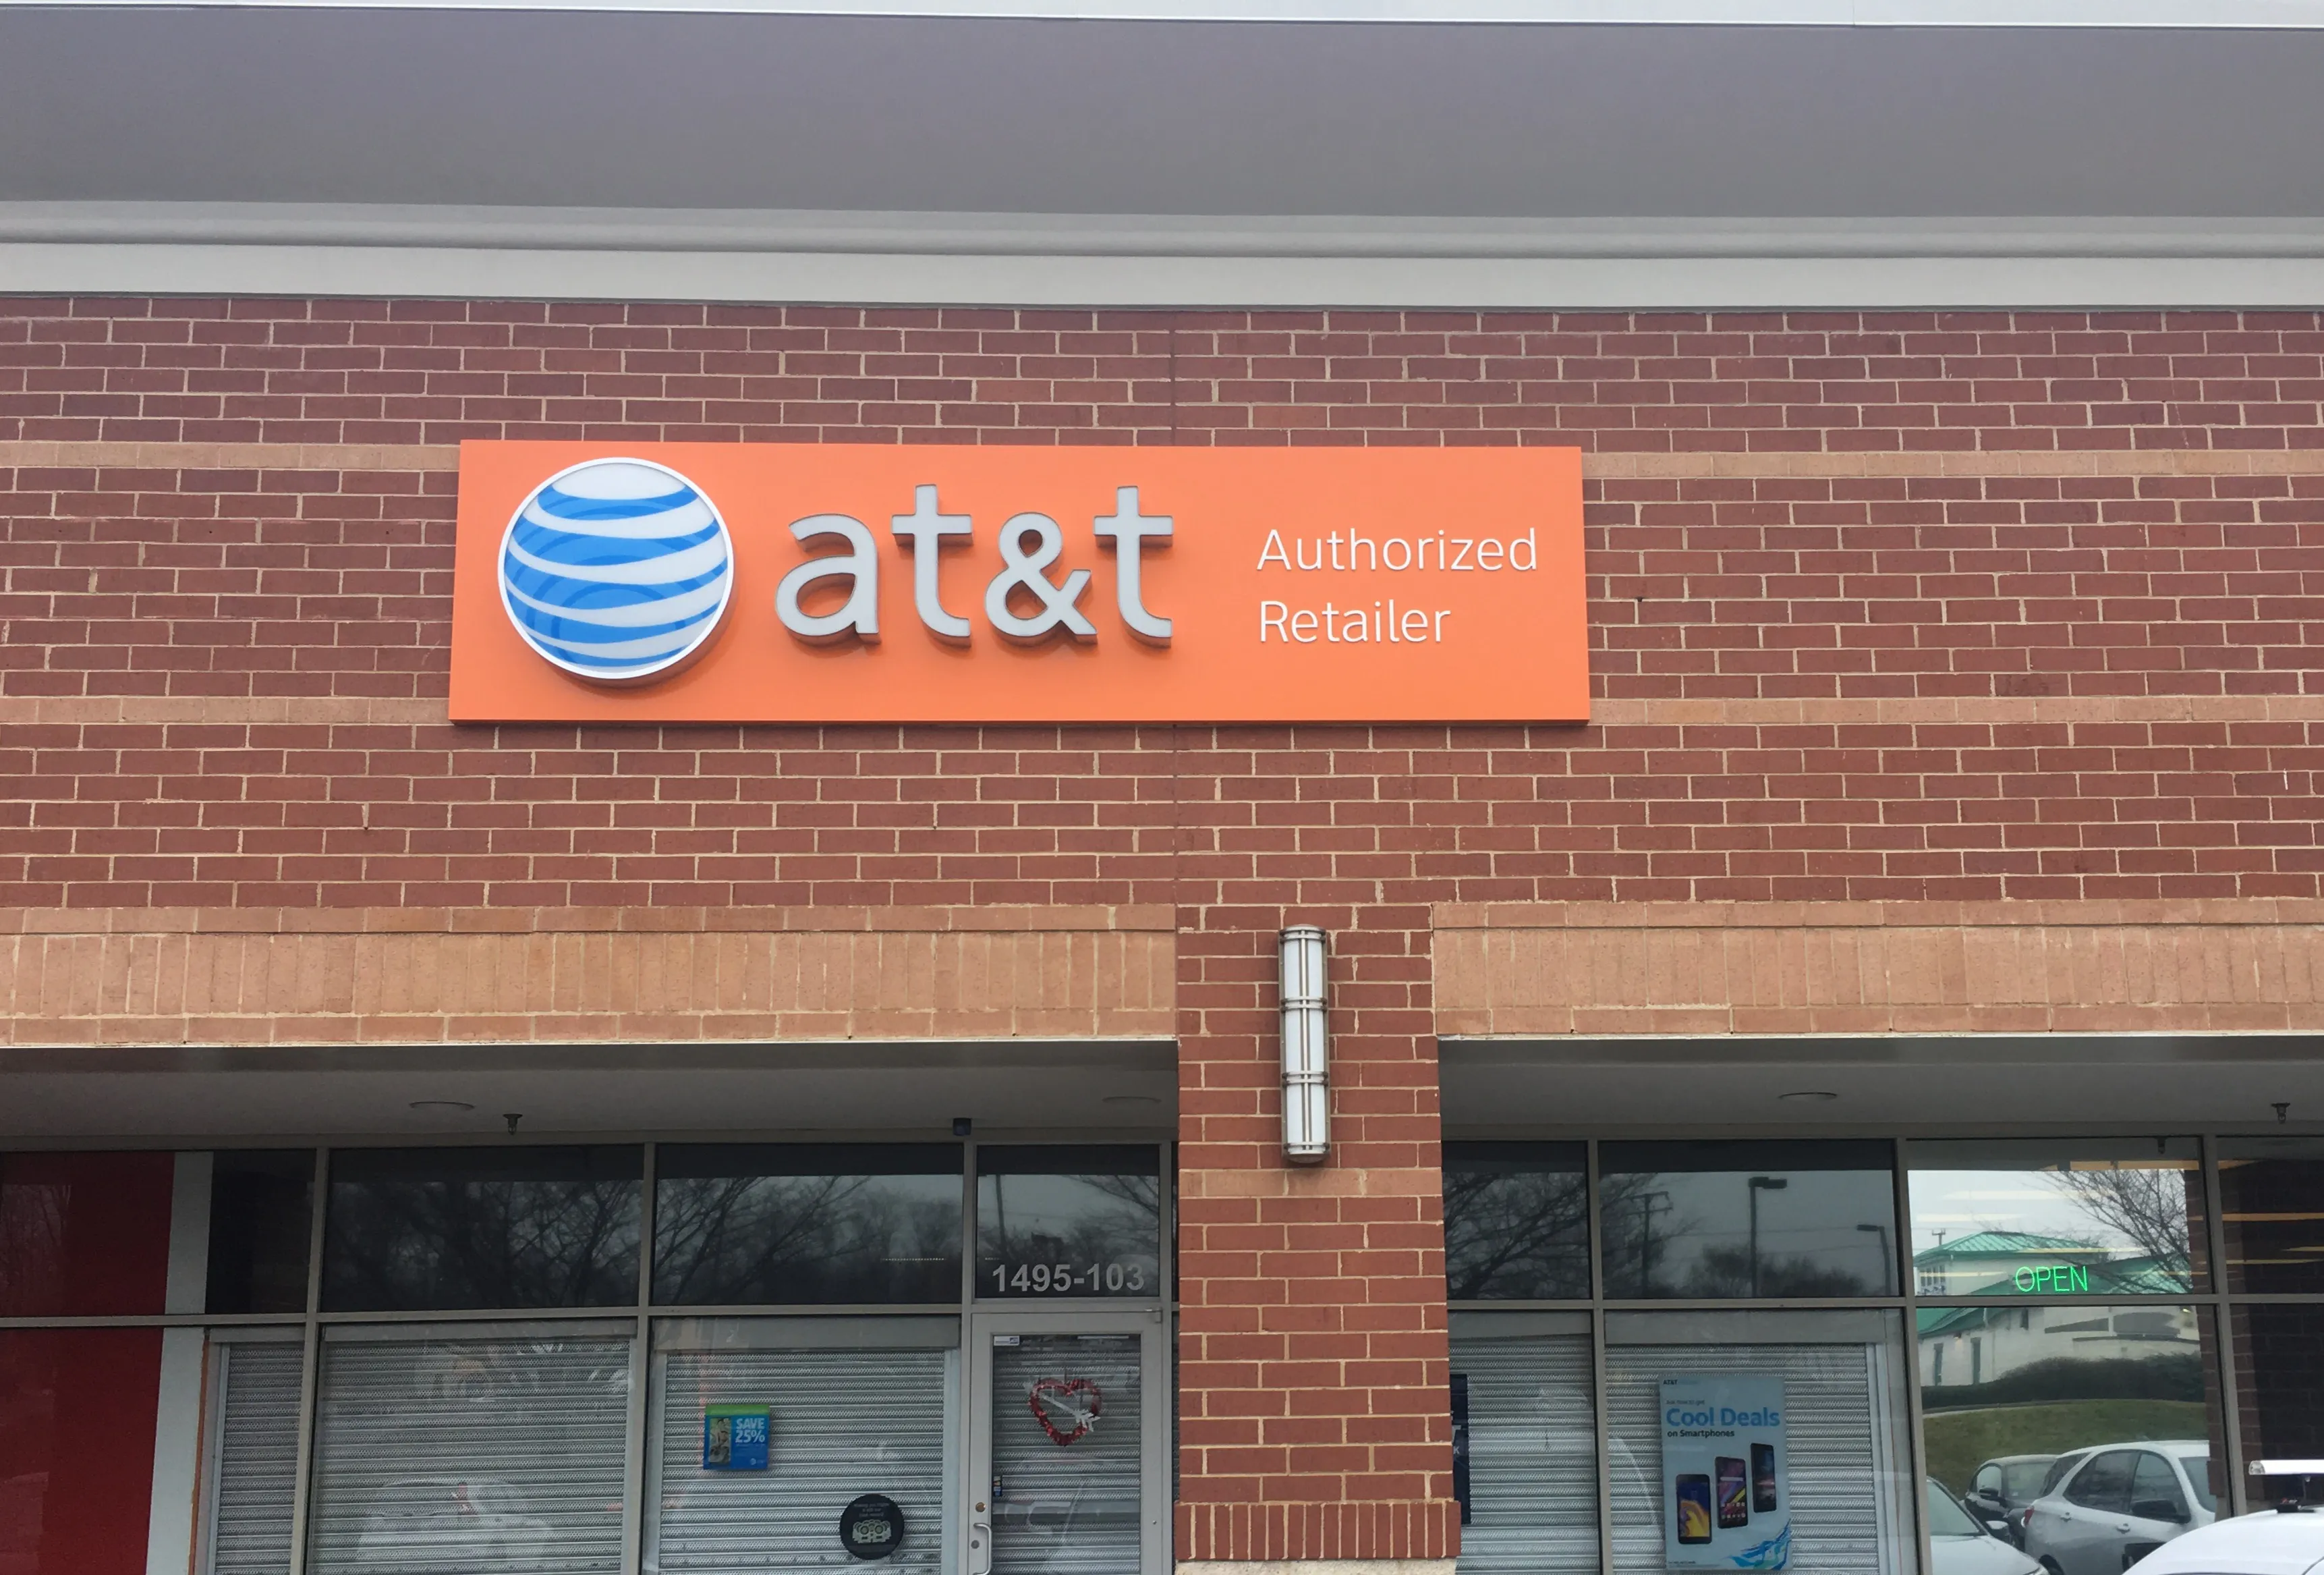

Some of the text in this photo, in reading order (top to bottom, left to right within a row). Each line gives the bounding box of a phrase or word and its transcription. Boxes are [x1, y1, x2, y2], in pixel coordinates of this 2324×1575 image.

[1256, 527, 1538, 571] Authorized
[775, 484, 1174, 645] at&t
[1259, 599, 1452, 643] Retailer
[992, 1263, 1145, 1292] 1495-103
[2015, 1266, 2088, 1292] OPEN
[735, 1418, 765, 1430] SAVE
[1666, 1407, 1781, 1427] Cool Deals
[735, 1430, 766, 1443] 25%
[1680, 1429, 1735, 1439] Smartphones
